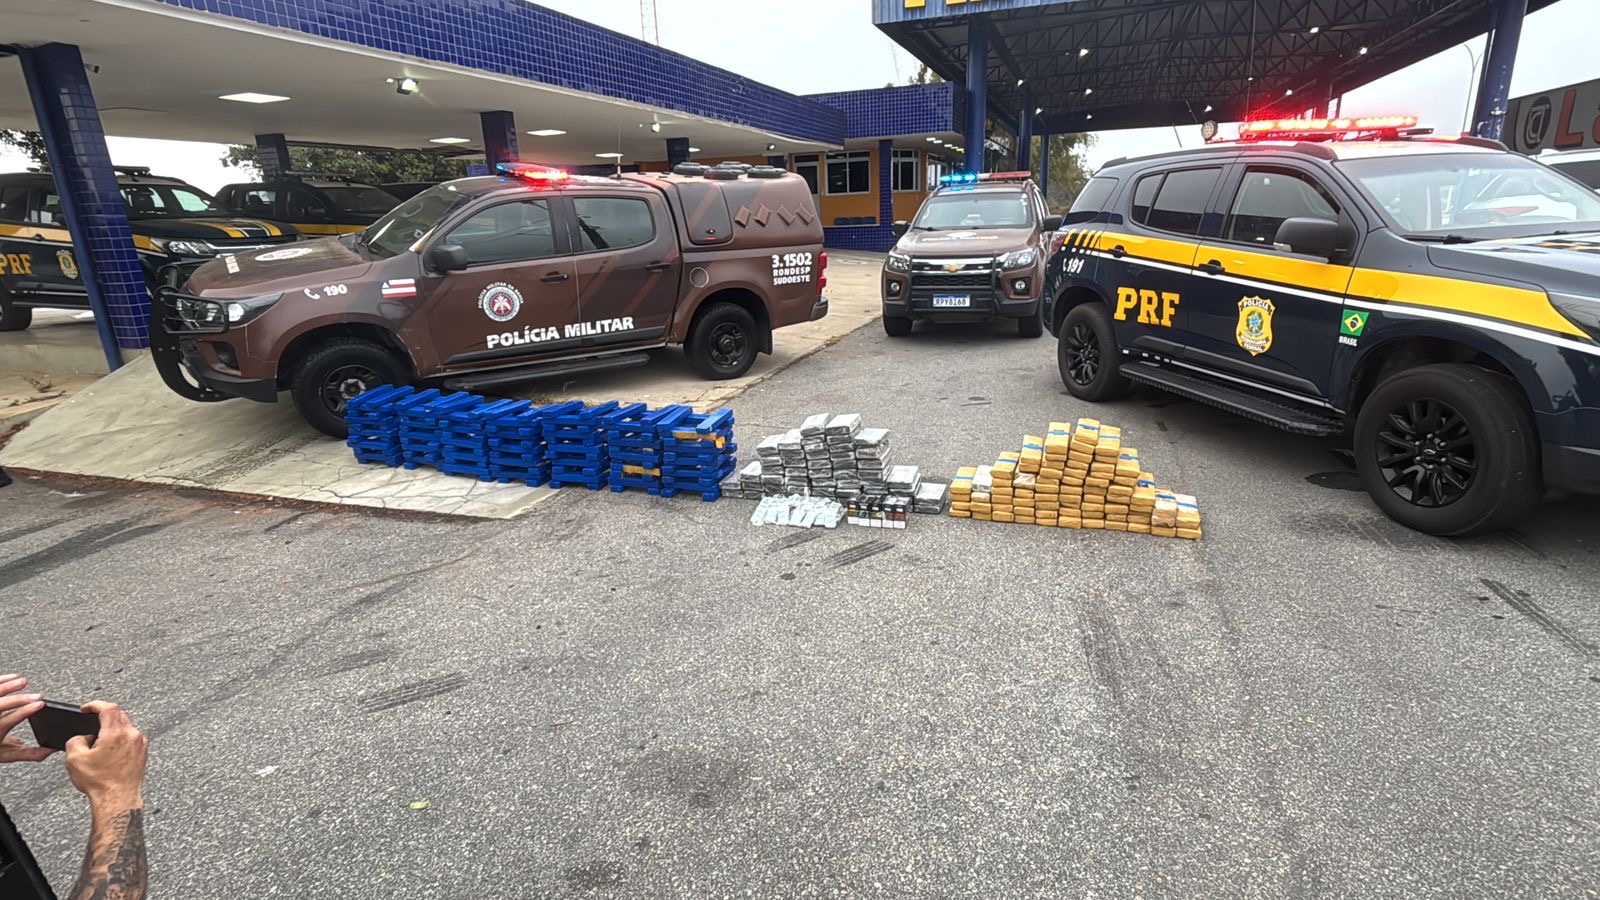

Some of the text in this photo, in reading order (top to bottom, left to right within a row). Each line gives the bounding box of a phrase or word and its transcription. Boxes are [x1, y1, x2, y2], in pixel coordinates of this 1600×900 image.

[0, 253, 32, 275] PRF
[771, 252, 812, 268] 3.1502
[1067, 257, 1085, 274] 191
[773, 266, 811, 277] RONDESP
[773, 274, 811, 286] SUDOESTE
[323, 284, 348, 297] 190
[1113, 286, 1180, 328] PRF
[486, 316, 635, 349] POLÍCIA MILITAR
